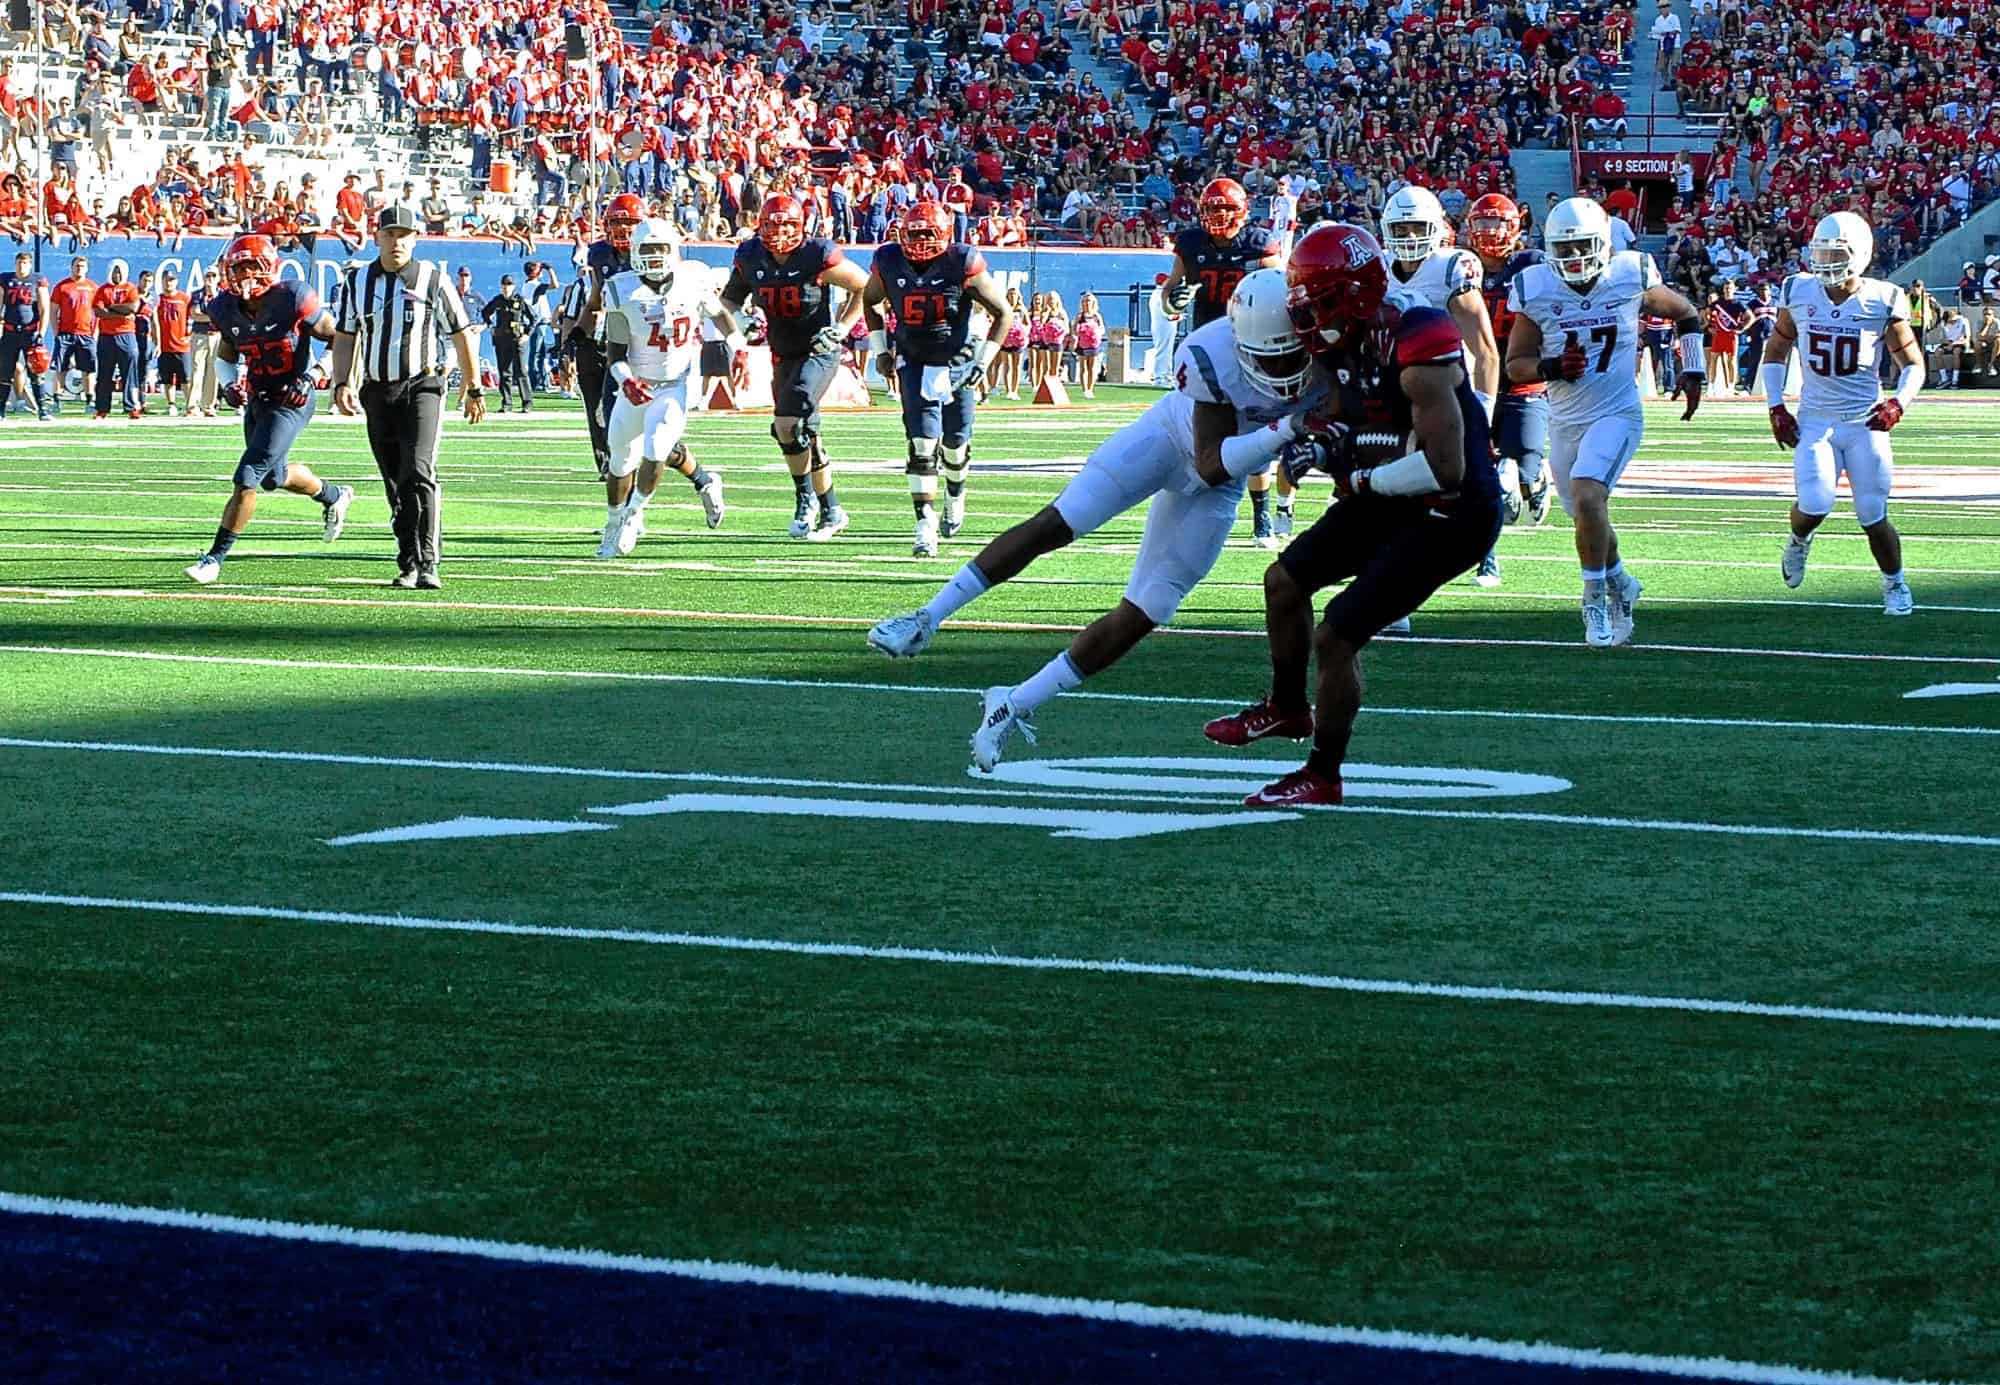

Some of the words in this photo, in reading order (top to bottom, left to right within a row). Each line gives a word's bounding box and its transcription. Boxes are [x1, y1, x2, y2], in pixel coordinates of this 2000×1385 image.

[1615, 159, 1623, 173] 9
[1625, 159, 1668, 173] SECTION
[647, 316, 691, 352] 40
[239, 339, 293, 375] 23
[1808, 332, 1860, 377] 50
